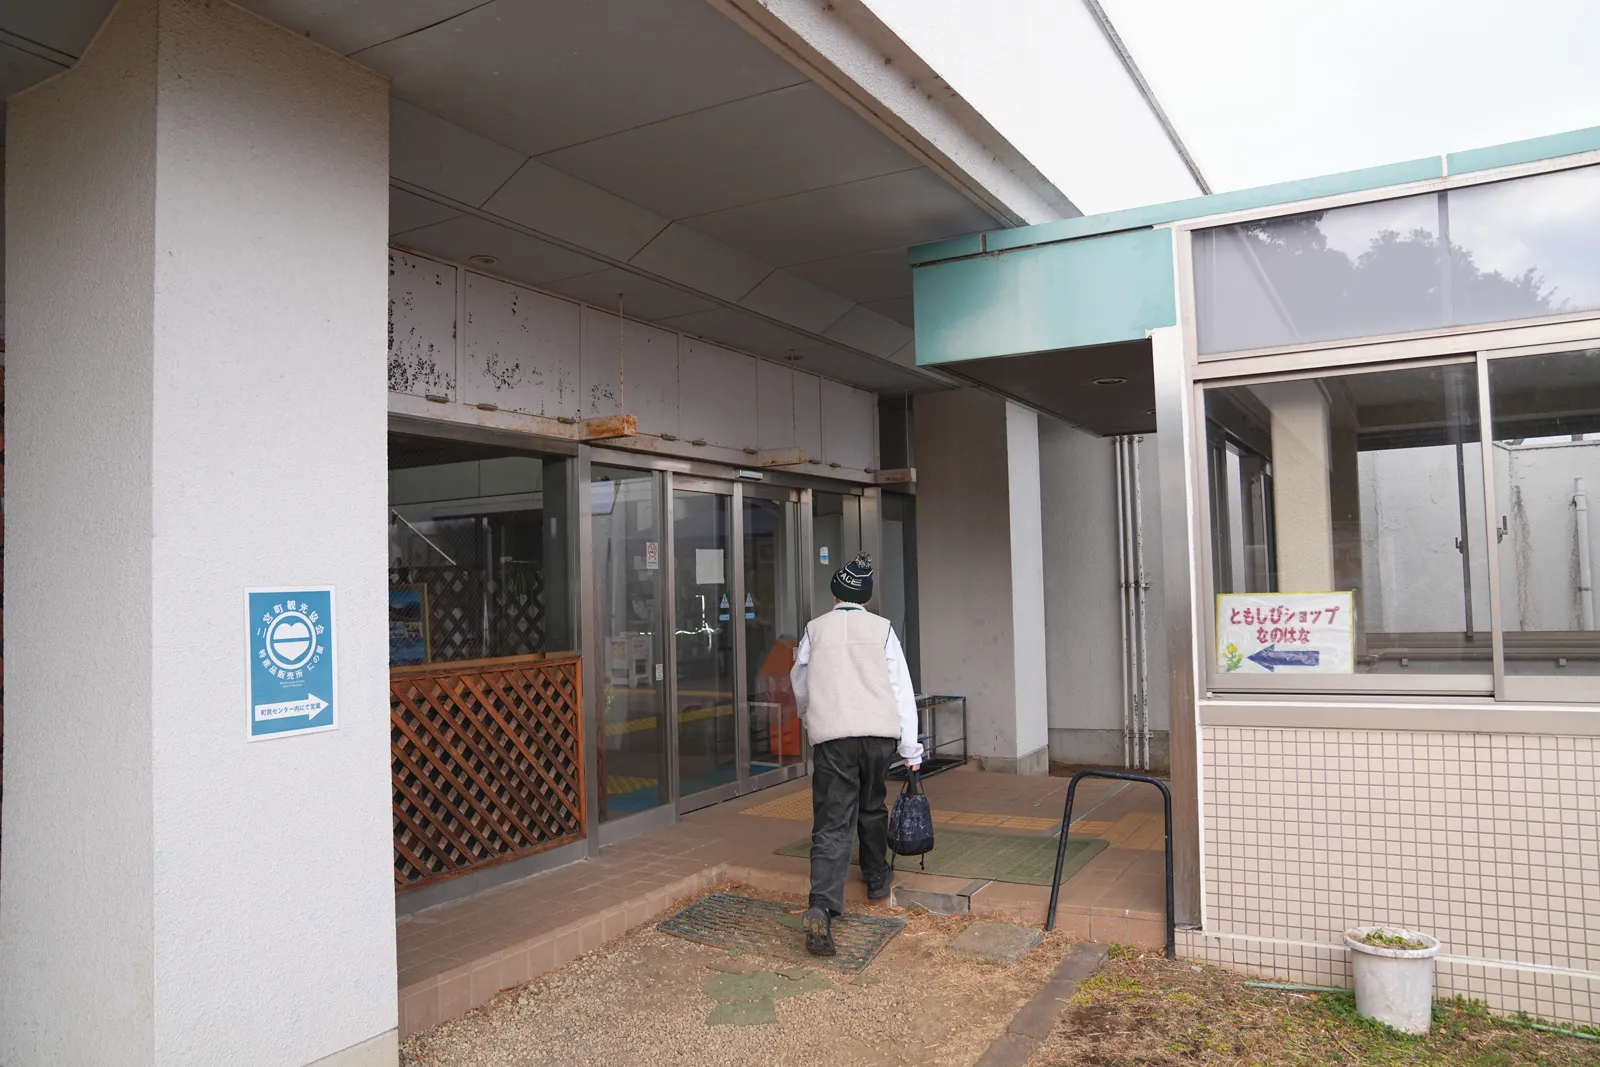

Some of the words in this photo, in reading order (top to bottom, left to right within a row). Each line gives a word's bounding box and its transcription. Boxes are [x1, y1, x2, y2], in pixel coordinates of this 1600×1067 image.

[1230, 605, 1340, 625] ともしびショップ
[1256, 626, 1311, 644] なのはな
